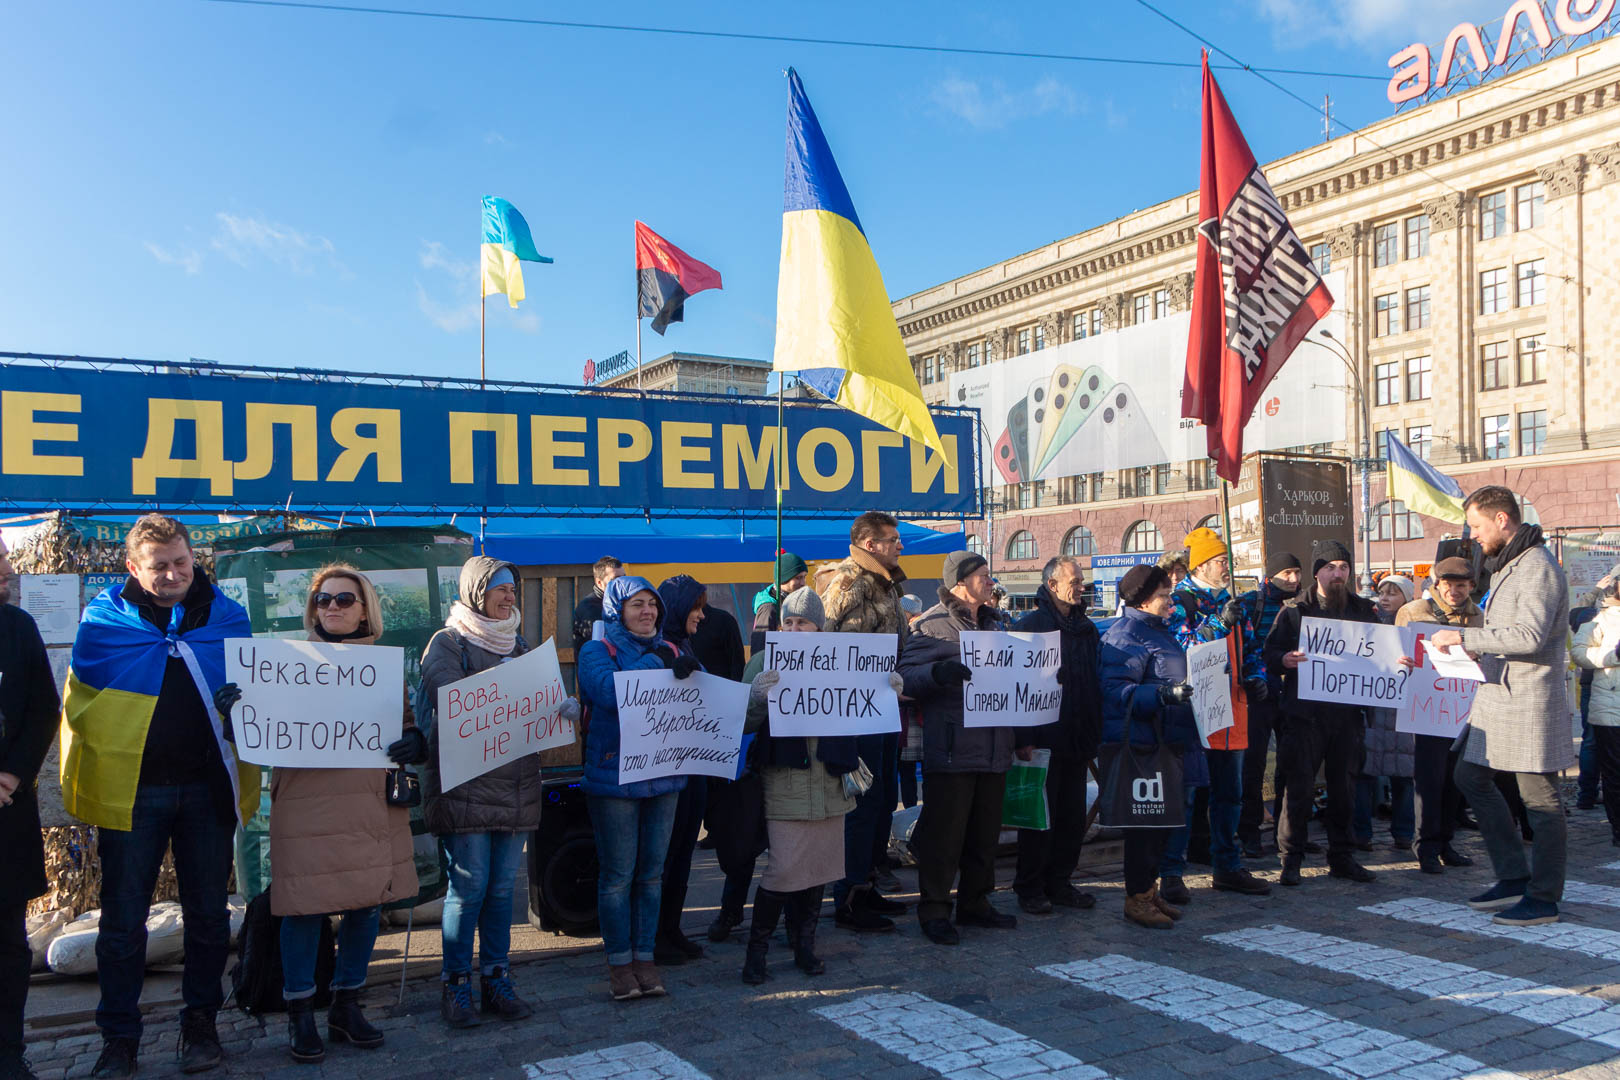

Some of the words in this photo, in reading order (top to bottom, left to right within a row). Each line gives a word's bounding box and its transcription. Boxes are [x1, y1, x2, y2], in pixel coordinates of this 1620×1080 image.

[596, 350, 628, 377] HUAWEI
[132, 398, 402, 496] ДЛЯ
[449, 411, 960, 494] ПЕРЕМОГИ
[1283, 489, 1330, 502] ХАРЬКОВ
[1272, 512, 1345, 526] СЛЕДУЮЩИЙ?
[87, 576, 106, 585] ДО
[1306, 625, 1346, 656] Who
[1356, 637, 1375, 657] is
[239, 646, 376, 687] Чекаємо
[810, 645, 839, 672] feat.
[1411, 694, 1473, 725] МАЙ
[622, 753, 648, 772] хто
